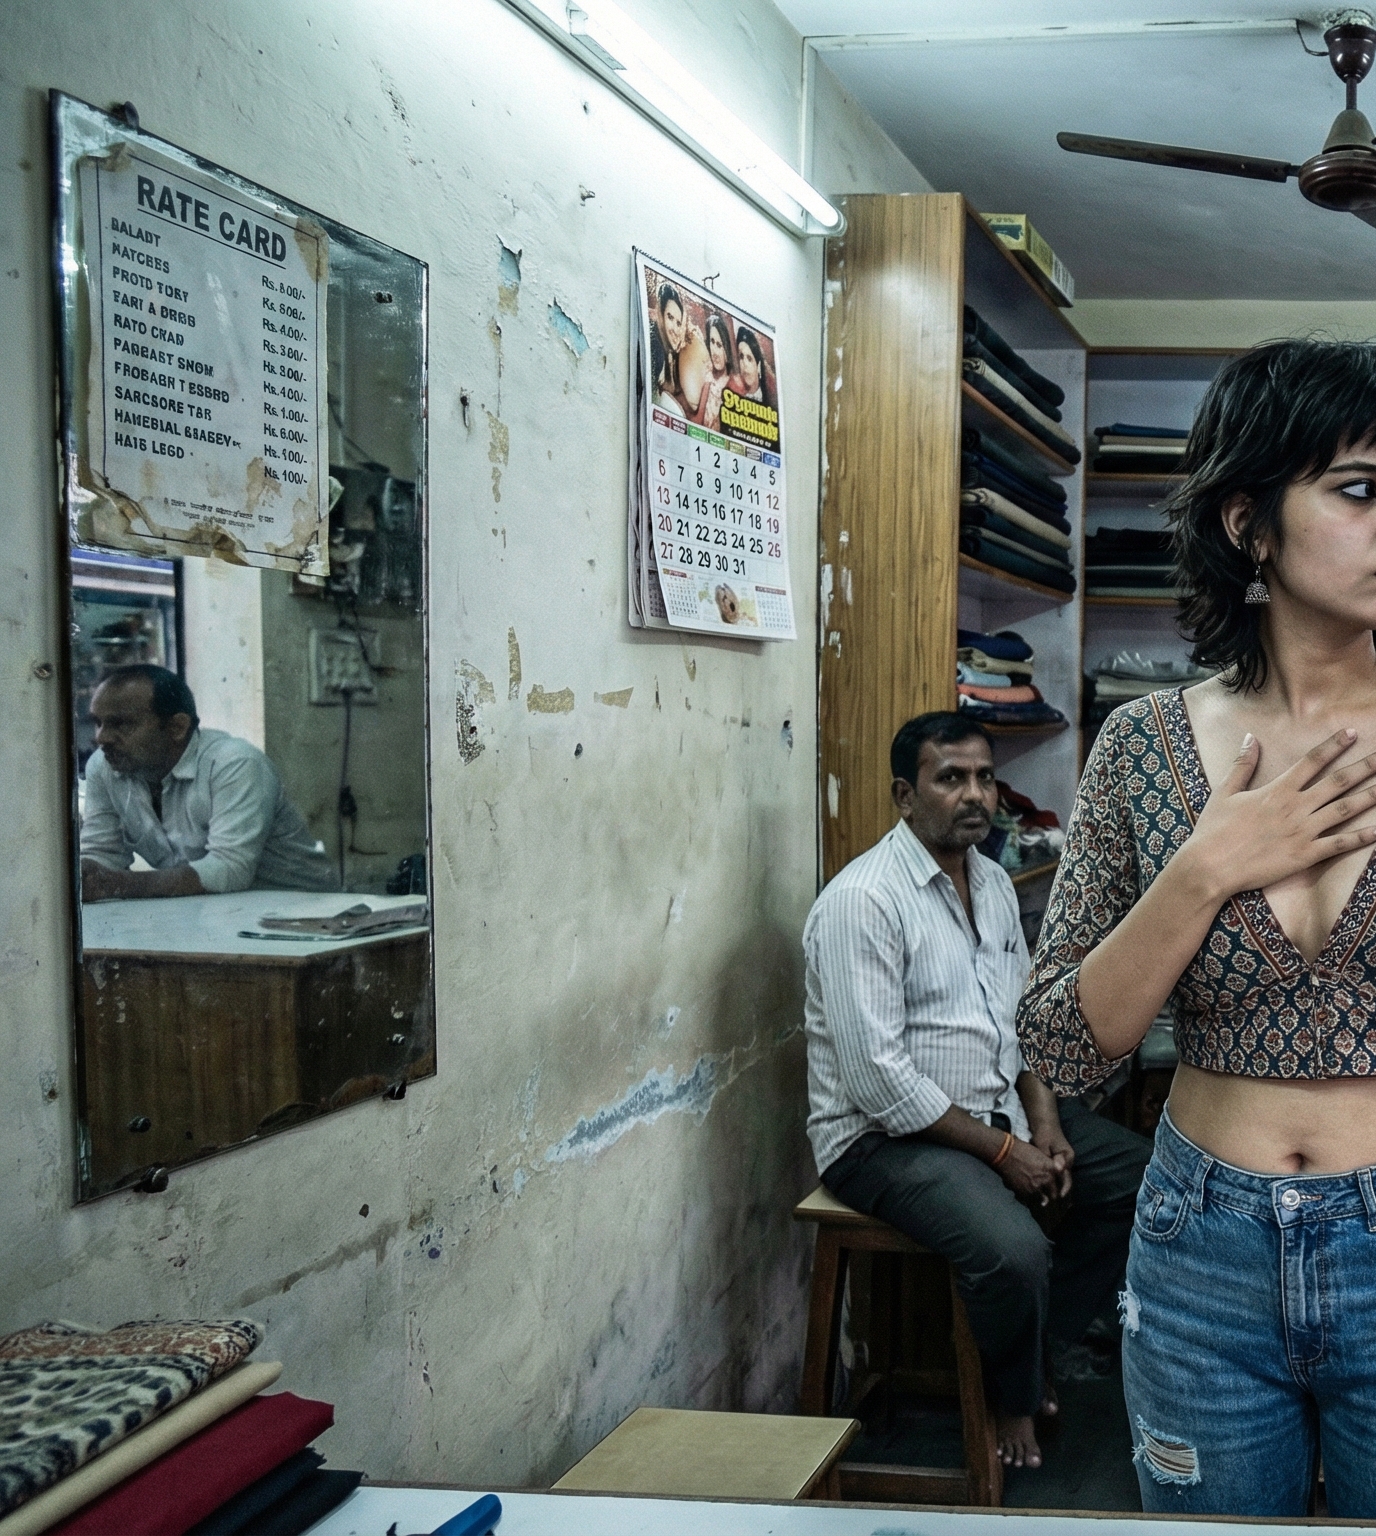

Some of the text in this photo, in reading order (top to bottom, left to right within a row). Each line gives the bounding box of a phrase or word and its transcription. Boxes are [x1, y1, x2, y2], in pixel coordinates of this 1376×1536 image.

[137, 174, 287, 263] RATE CARD
[659, 459, 779, 510] 6 7 8 9 10 11 12
[696, 446, 700, 462] 1
[714, 452, 720, 468] 2
[733, 459, 739, 474] 3
[750, 466, 756, 479] 4
[657, 486, 779, 534] 13 14 15 16 17 18 19
[658, 513, 672, 532] 20
[677, 519, 689, 537] 21
[695, 524, 710, 542] 22
[714, 529, 727, 546] 23
[731, 533, 745, 550] 24
[749, 538, 763, 554] 25
[661, 542, 745, 575] 27 28 29 30 31
